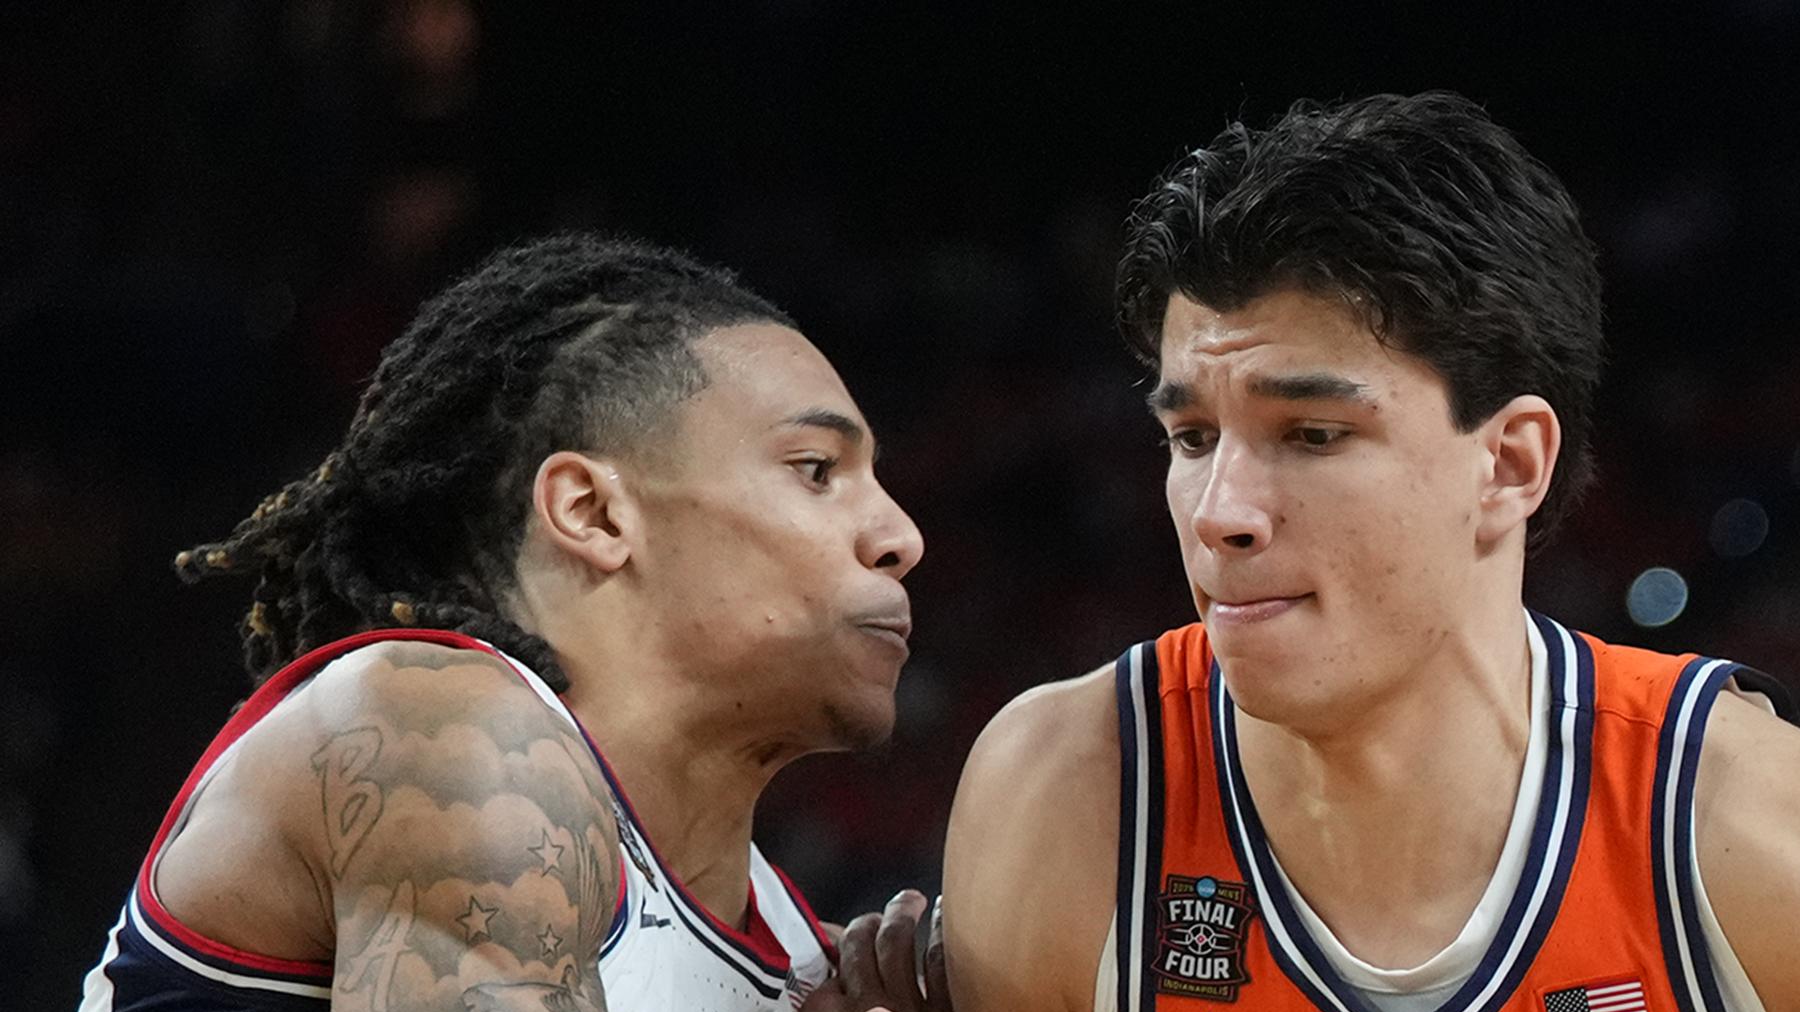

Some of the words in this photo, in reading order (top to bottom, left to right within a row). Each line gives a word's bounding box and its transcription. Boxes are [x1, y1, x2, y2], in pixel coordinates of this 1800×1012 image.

[1168, 899, 1236, 930] FINAL
[1164, 950, 1230, 980] FOUR
[1163, 979, 1229, 996] INDIANAPOLIS
